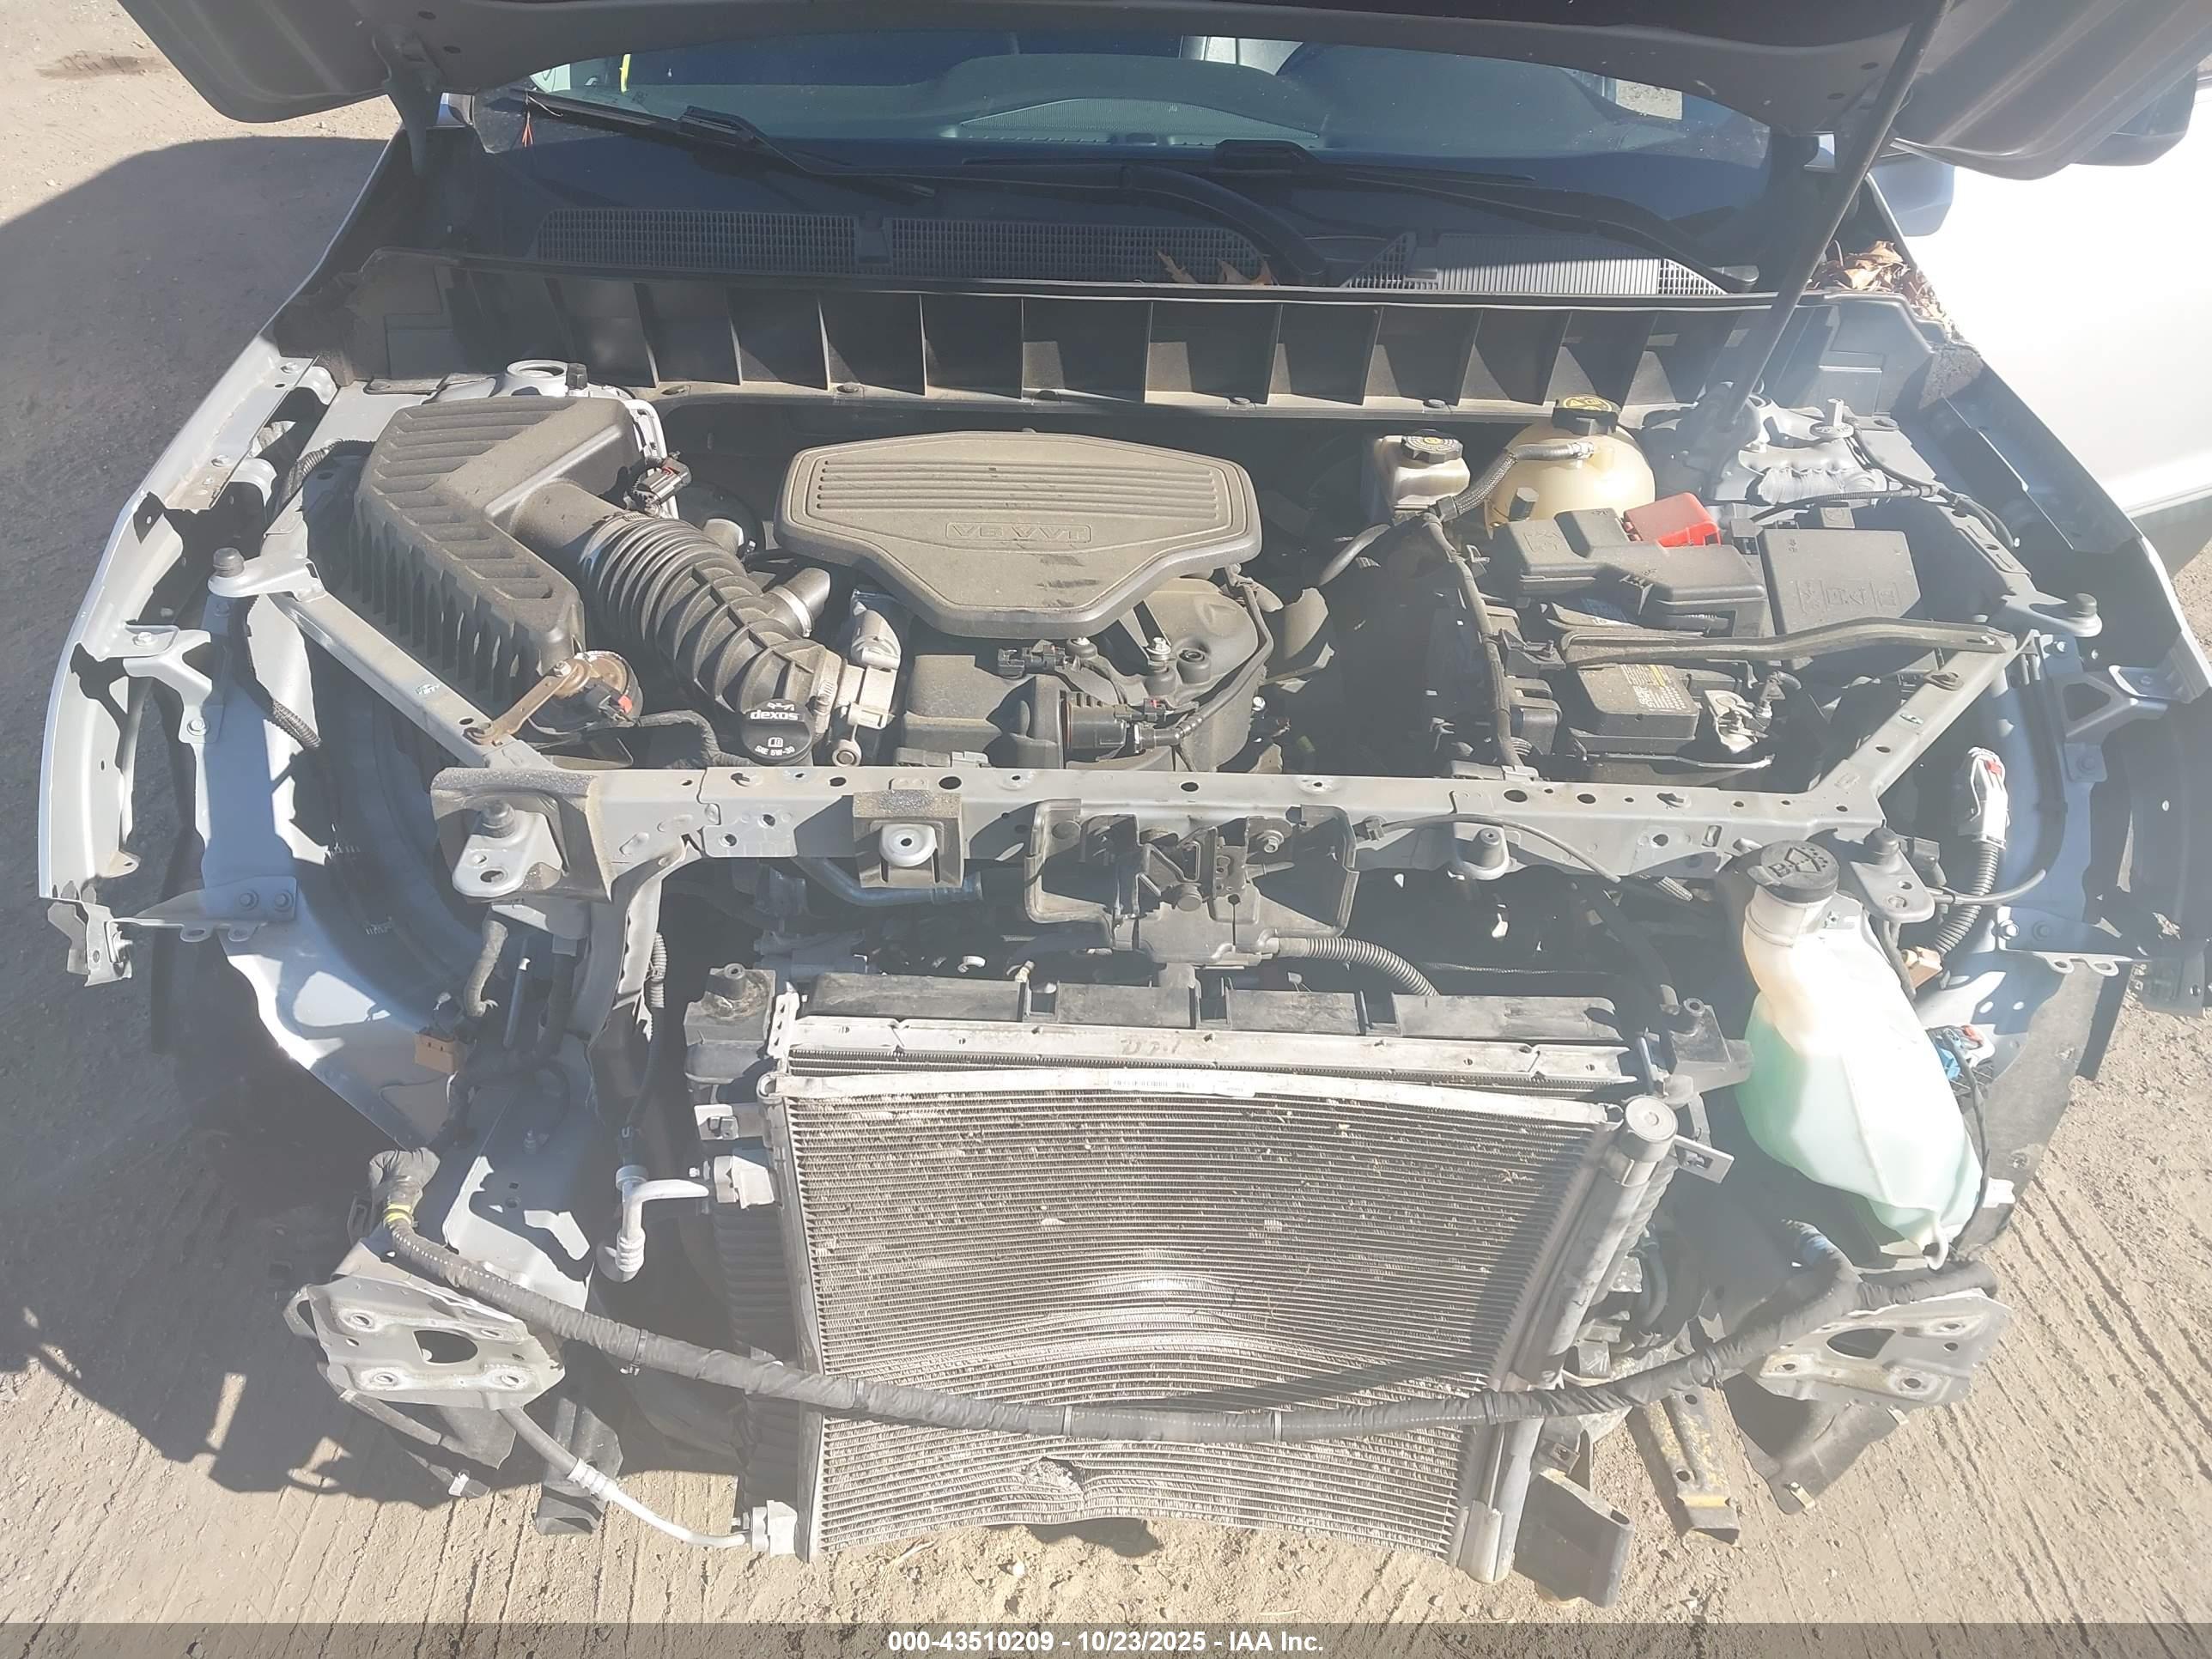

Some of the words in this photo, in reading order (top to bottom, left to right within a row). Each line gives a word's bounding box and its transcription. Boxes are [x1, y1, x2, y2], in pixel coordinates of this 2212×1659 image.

[1011, 526, 1087, 540] VVT
[750, 709, 799, 720] dexos
[770, 746, 795, 756] 5W-30
